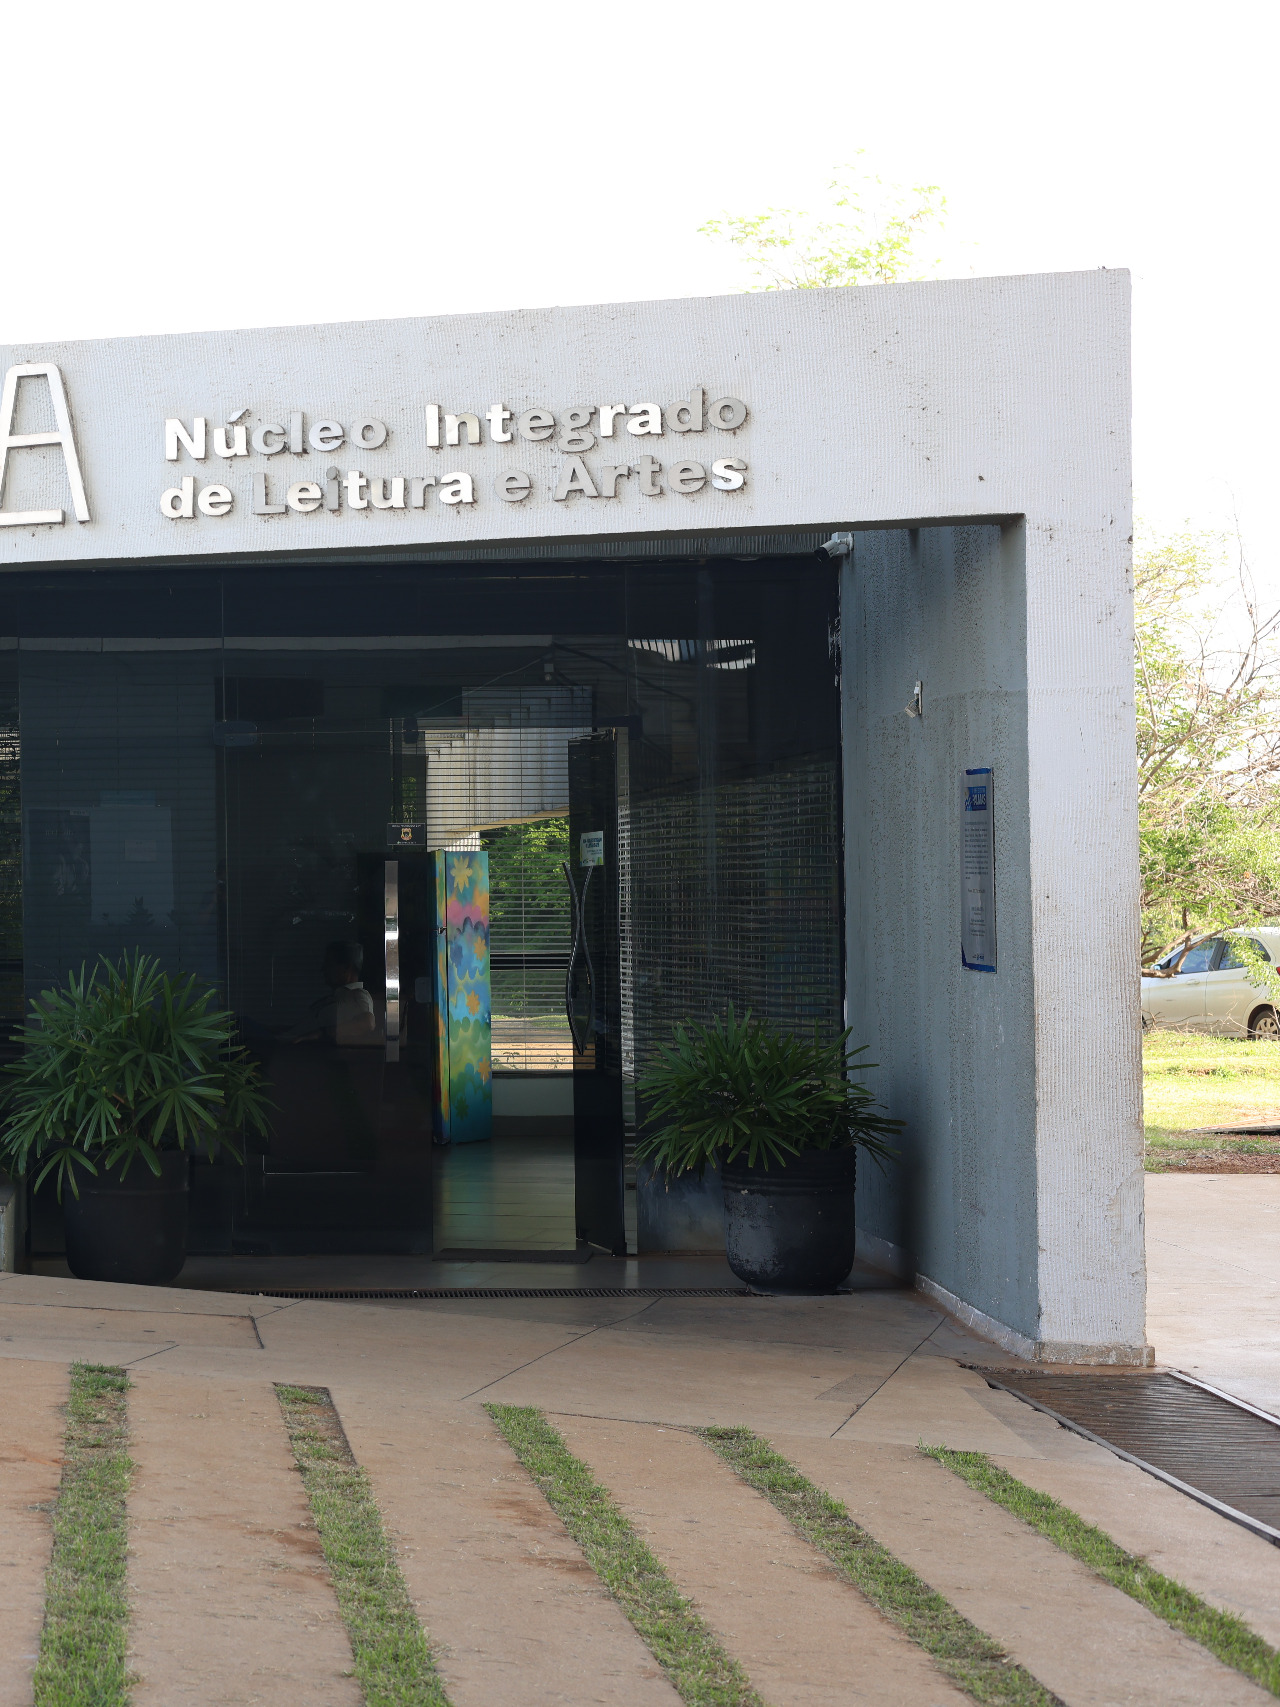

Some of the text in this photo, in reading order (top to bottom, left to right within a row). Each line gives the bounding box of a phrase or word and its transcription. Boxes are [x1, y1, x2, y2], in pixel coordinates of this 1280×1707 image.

[164, 387, 749, 462] Núcleo Integrado
[160, 453, 749, 519] de Leitura e Artes
